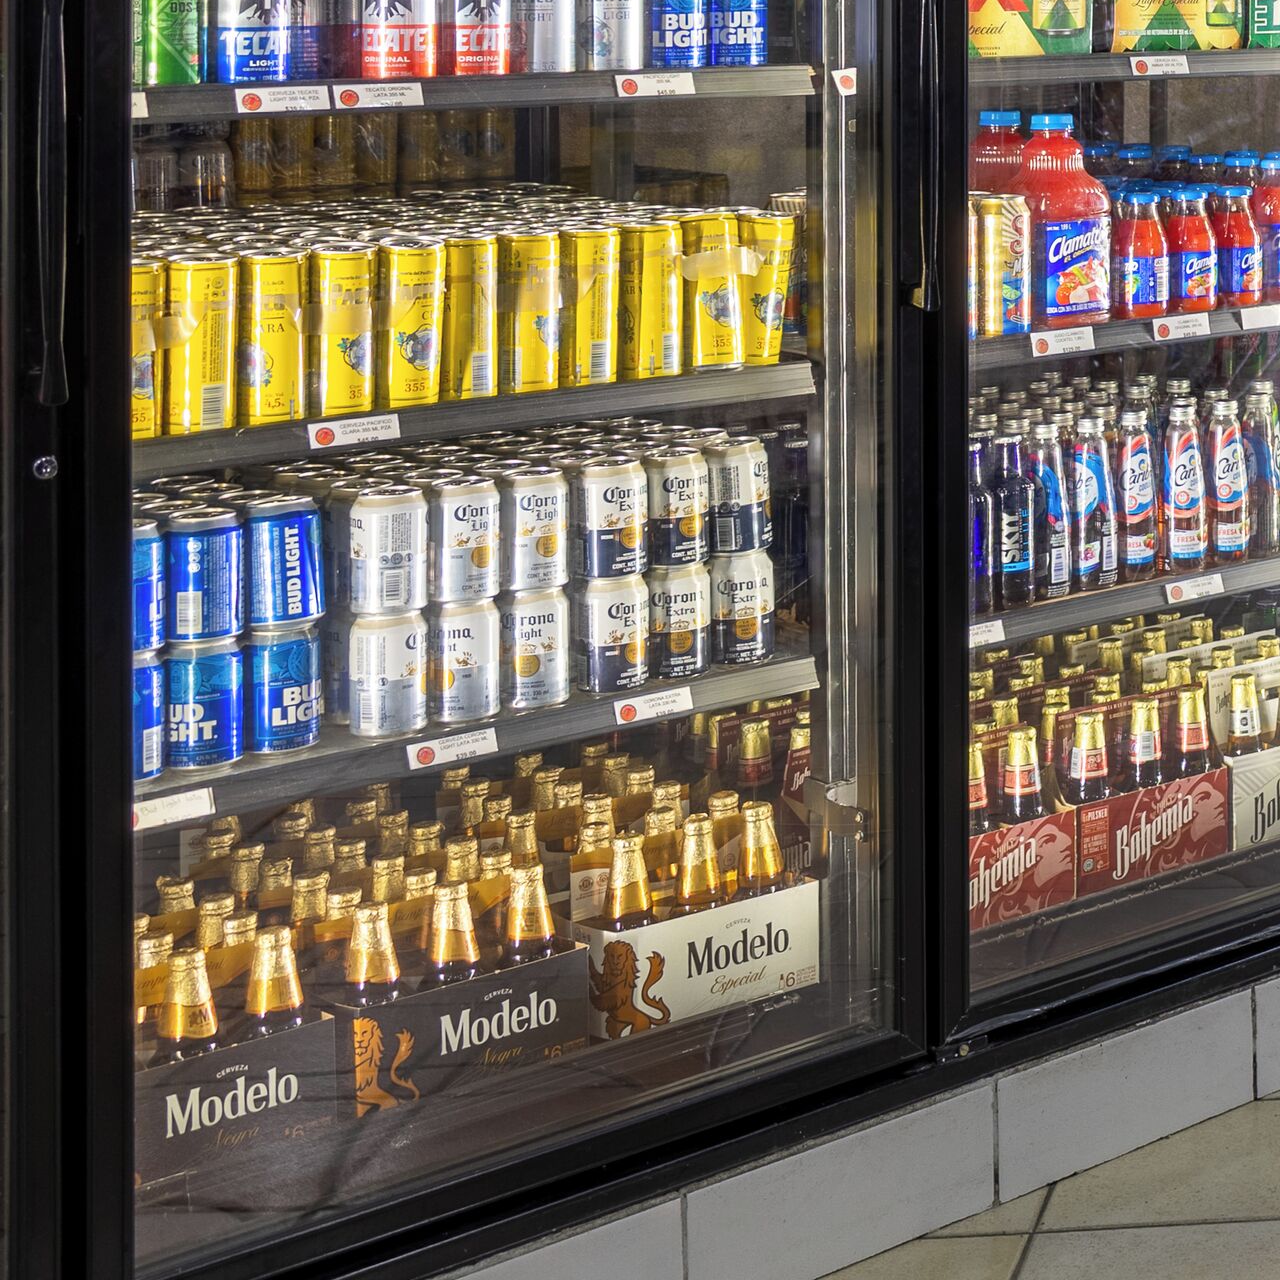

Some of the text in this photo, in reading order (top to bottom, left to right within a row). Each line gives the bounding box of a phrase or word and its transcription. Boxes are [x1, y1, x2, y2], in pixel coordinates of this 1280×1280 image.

[516, 12, 555, 22] LIGHT
[663, 12, 706, 31] BUD
[364, 29, 427, 52] ECATE
[249, 60, 280, 68] LIGHT
[284, 523, 302, 615] LIGHT BUD
[651, 589, 704, 611] Corona
[665, 604, 696, 617] Extra
[1113, 792, 1194, 881] Bohemia
[969, 836, 1037, 911] ohemia
[725, 918, 751, 930] CERVEZA
[687, 923, 791, 979] Modelo
[710, 965, 767, 997] Especial
[785, 971, 796, 987] 6
[484, 987, 513, 1002] CERVEZA
[440, 991, 558, 1058] Modelo
[216, 1064, 249, 1079] CERVEZA
[166, 1067, 299, 1140] Modelo
